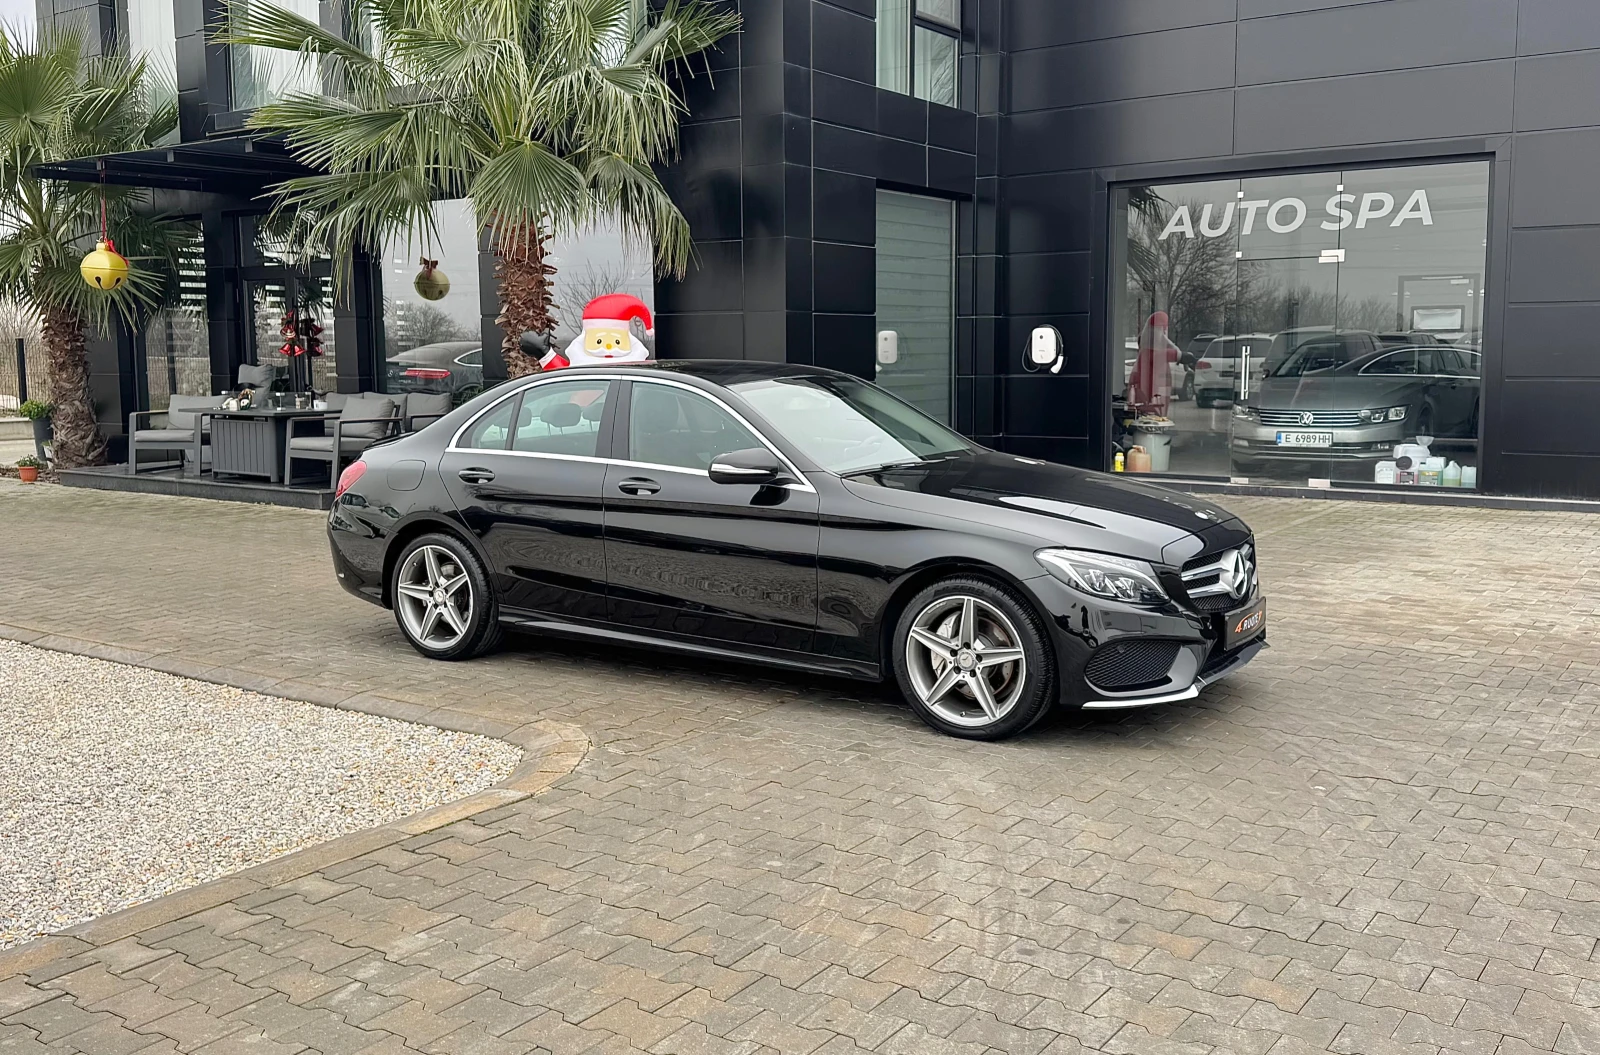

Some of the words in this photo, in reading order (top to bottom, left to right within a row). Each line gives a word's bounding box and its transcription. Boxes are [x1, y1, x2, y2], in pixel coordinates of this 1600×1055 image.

[1158, 197, 1307, 240] AUTO
[1320, 189, 1434, 231] SPA
[1285, 434, 1291, 443] E
